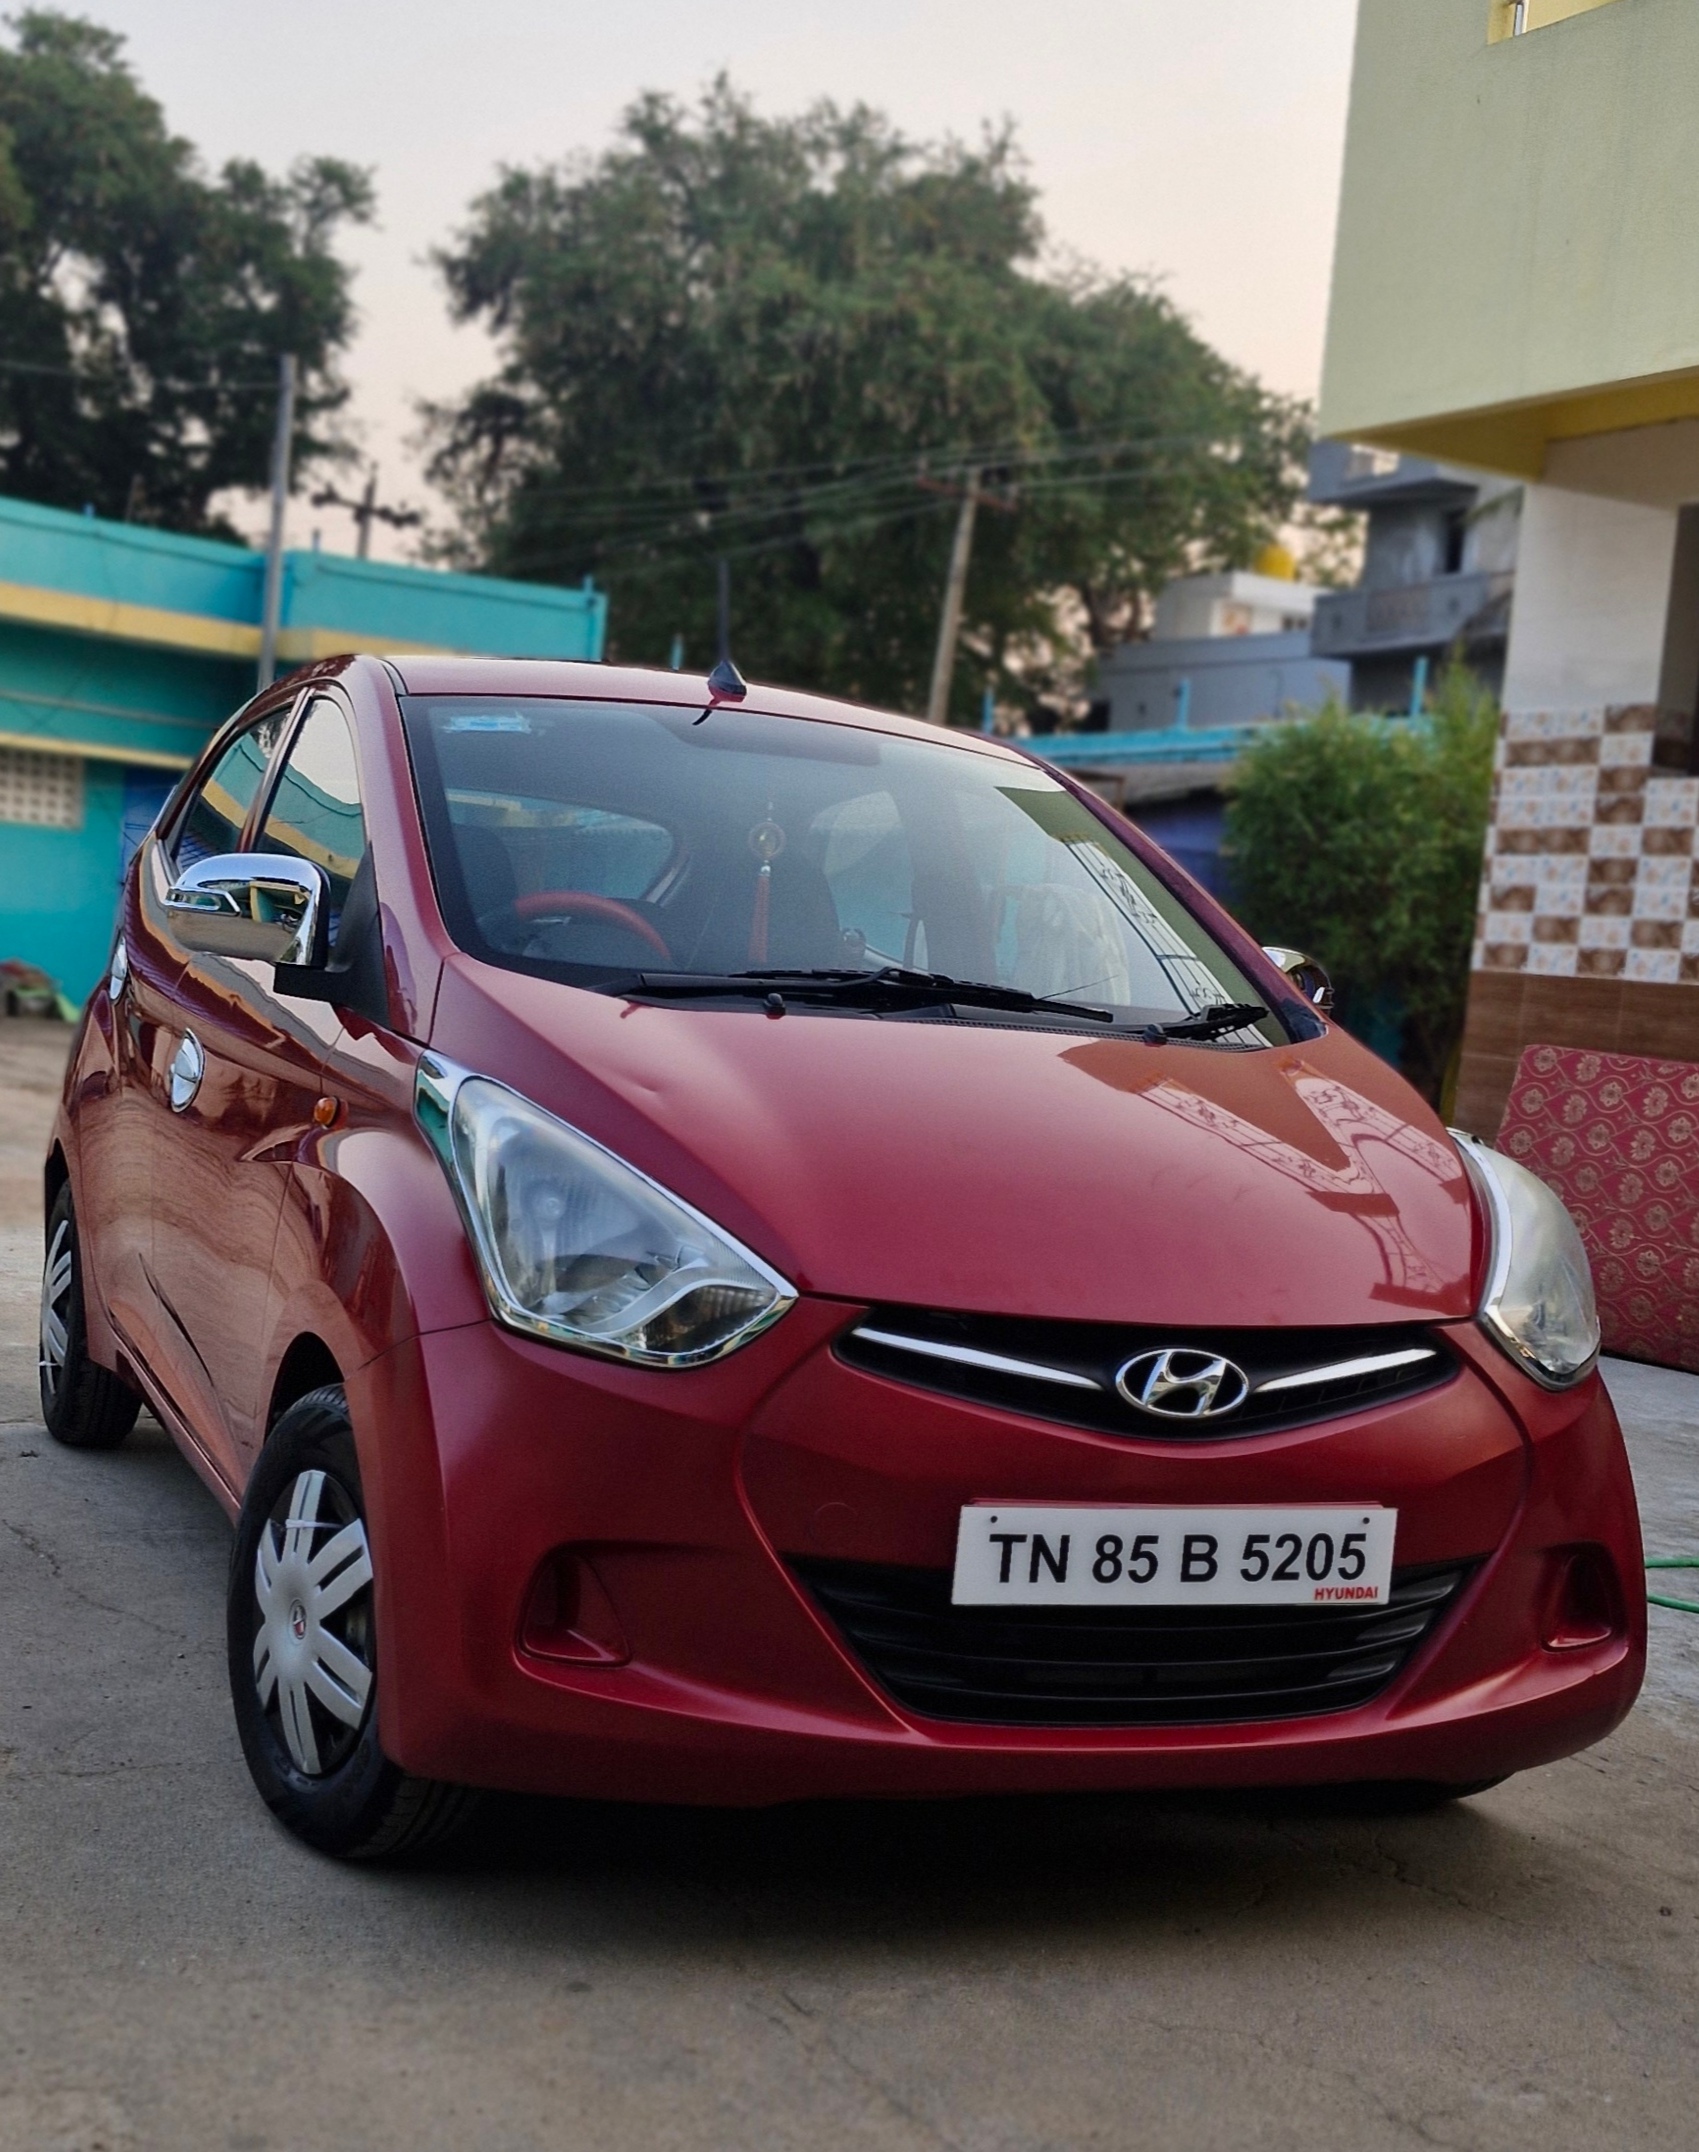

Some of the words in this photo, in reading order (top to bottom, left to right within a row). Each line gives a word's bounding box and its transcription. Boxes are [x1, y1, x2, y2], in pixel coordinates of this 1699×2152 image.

[988, 1533, 1071, 1584] TN
[1091, 1534, 1160, 1584] 85
[1179, 1534, 1219, 1583] B
[1239, 1532, 1367, 1583] 5205
[1314, 1586, 1379, 1600] HYUNDAI
